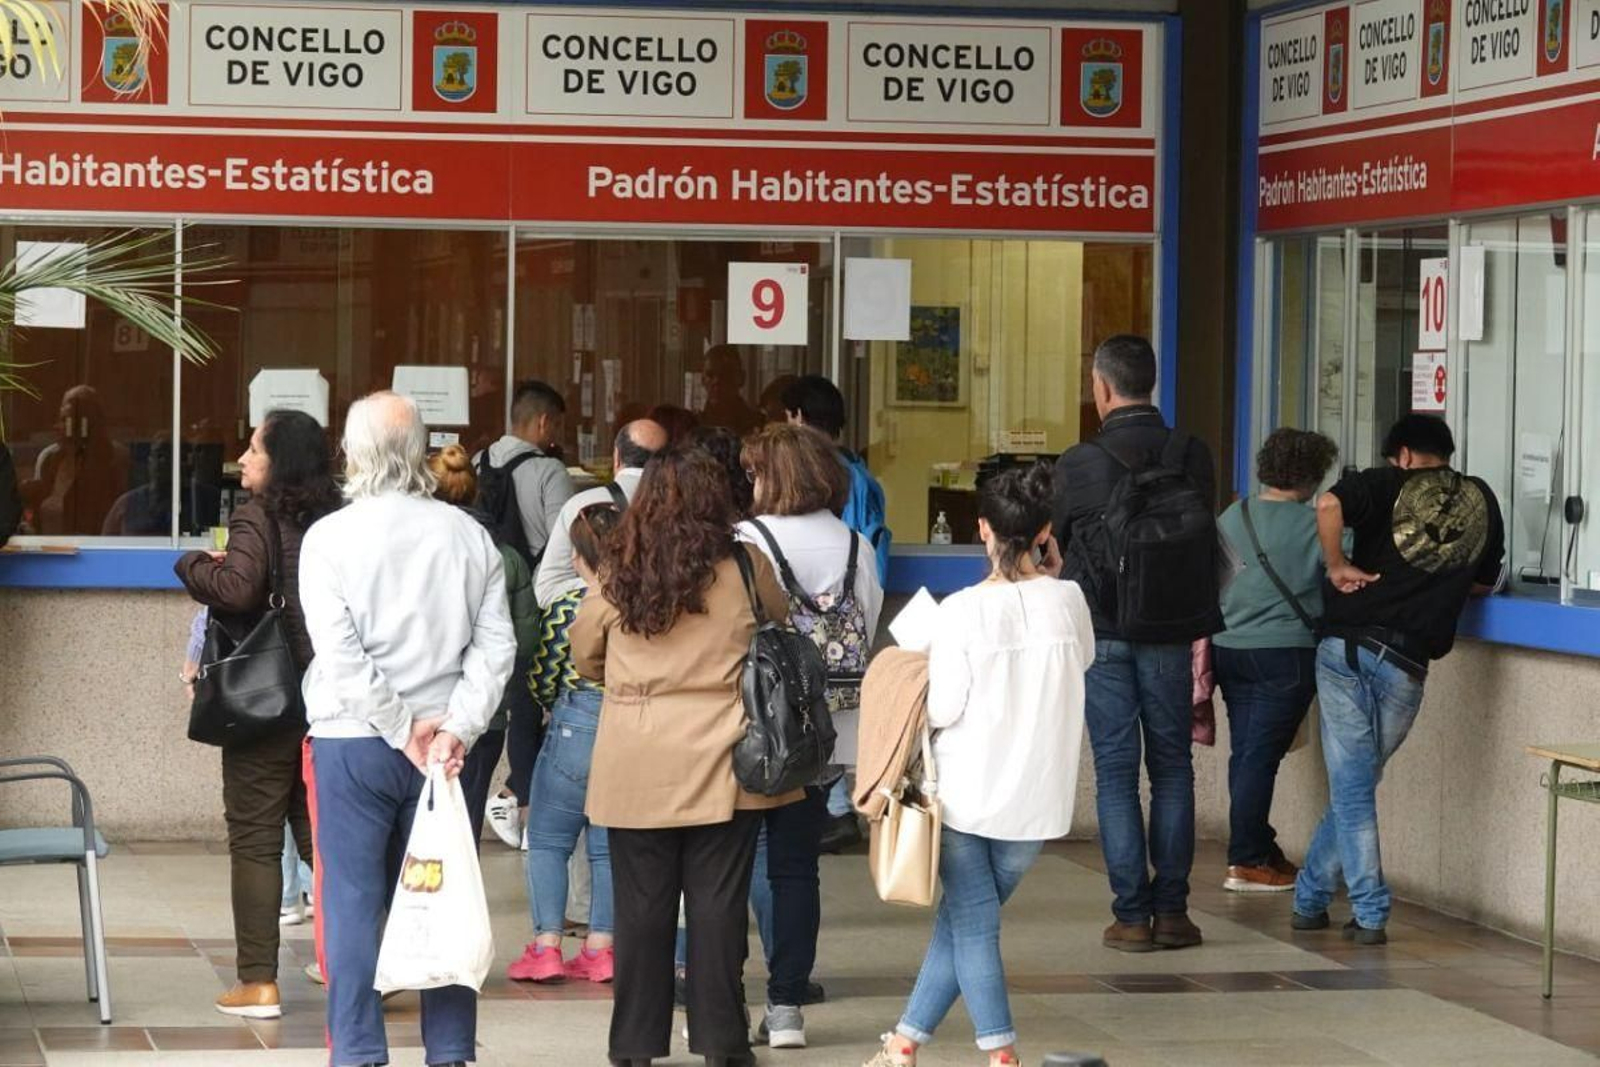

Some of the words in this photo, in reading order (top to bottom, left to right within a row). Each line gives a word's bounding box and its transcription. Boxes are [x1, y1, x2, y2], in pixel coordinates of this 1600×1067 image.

[206, 25, 384, 54] CONCELLO
[1360, 13, 1414, 50] CONCELLO
[1472, 35, 1486, 64] DE
[1491, 28, 1519, 59] VIGO
[543, 35, 717, 63] CONCELLO
[863, 42, 1034, 71] CONCELLO
[1267, 35, 1317, 70] CONCELLO
[228, 60, 269, 85] DE
[283, 62, 363, 87] VIGO
[564, 69, 604, 93] DE
[618, 70, 696, 96] VIGO
[1365, 57, 1378, 85] DE
[1382, 52, 1406, 81] VIGO
[884, 77, 924, 101] DE
[937, 78, 1014, 104] VIGO
[1272, 76, 1285, 103] DE
[1287, 71, 1310, 99] VIGO
[0, 153, 432, 193] Habitantes-Estatística
[589, 167, 717, 199] Padrón
[733, 170, 1147, 207] Habitantes-Estatística
[1259, 170, 1294, 207] Padrón
[1298, 155, 1427, 204] Habitantes-Estatística
[752, 279, 784, 328] 9
[1422, 276, 1444, 332] 10
